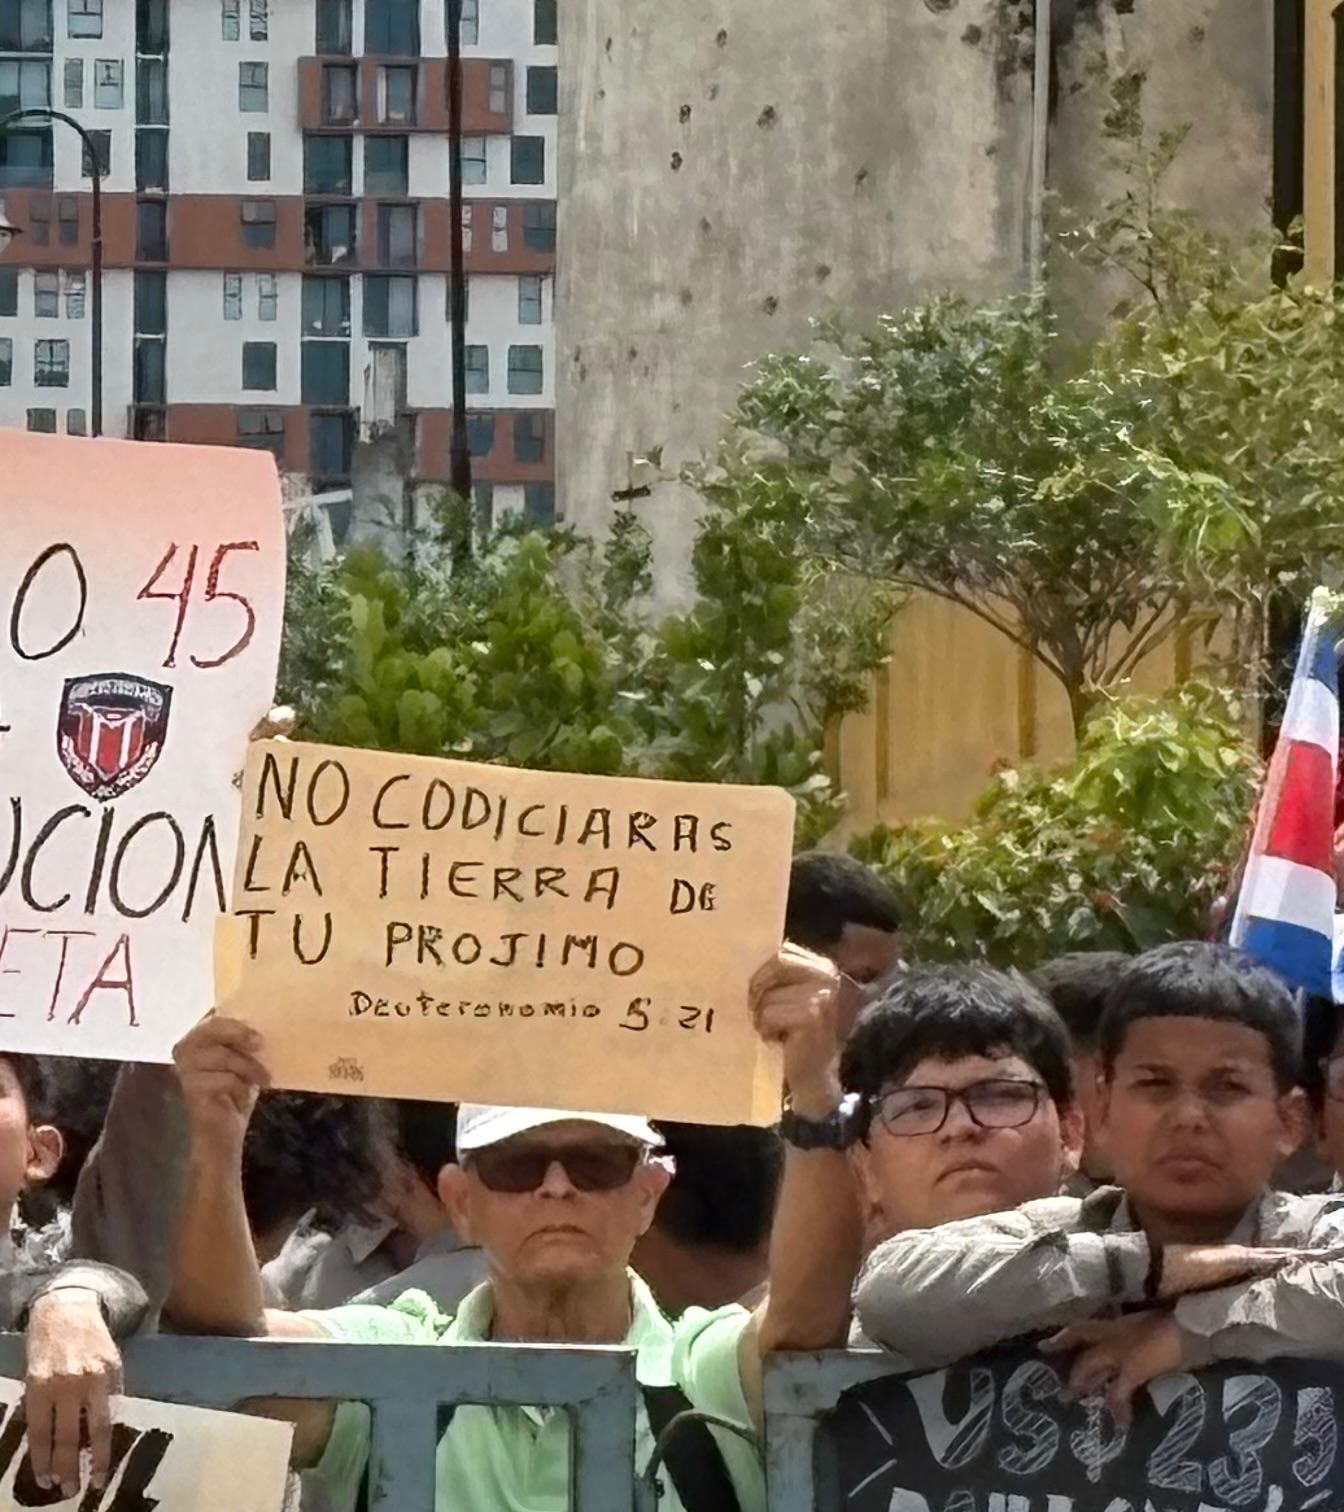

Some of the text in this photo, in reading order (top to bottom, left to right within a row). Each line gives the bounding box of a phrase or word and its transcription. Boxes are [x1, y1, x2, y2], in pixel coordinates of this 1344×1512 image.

[137, 541, 260, 669] 45
[256, 752, 733, 853] NO CODICIARAS
[243, 834, 717, 914] LA TIERRA DE
[234, 910, 645, 976] TU PROJIMO
[349, 990, 601, 1018] Deuteronomio
